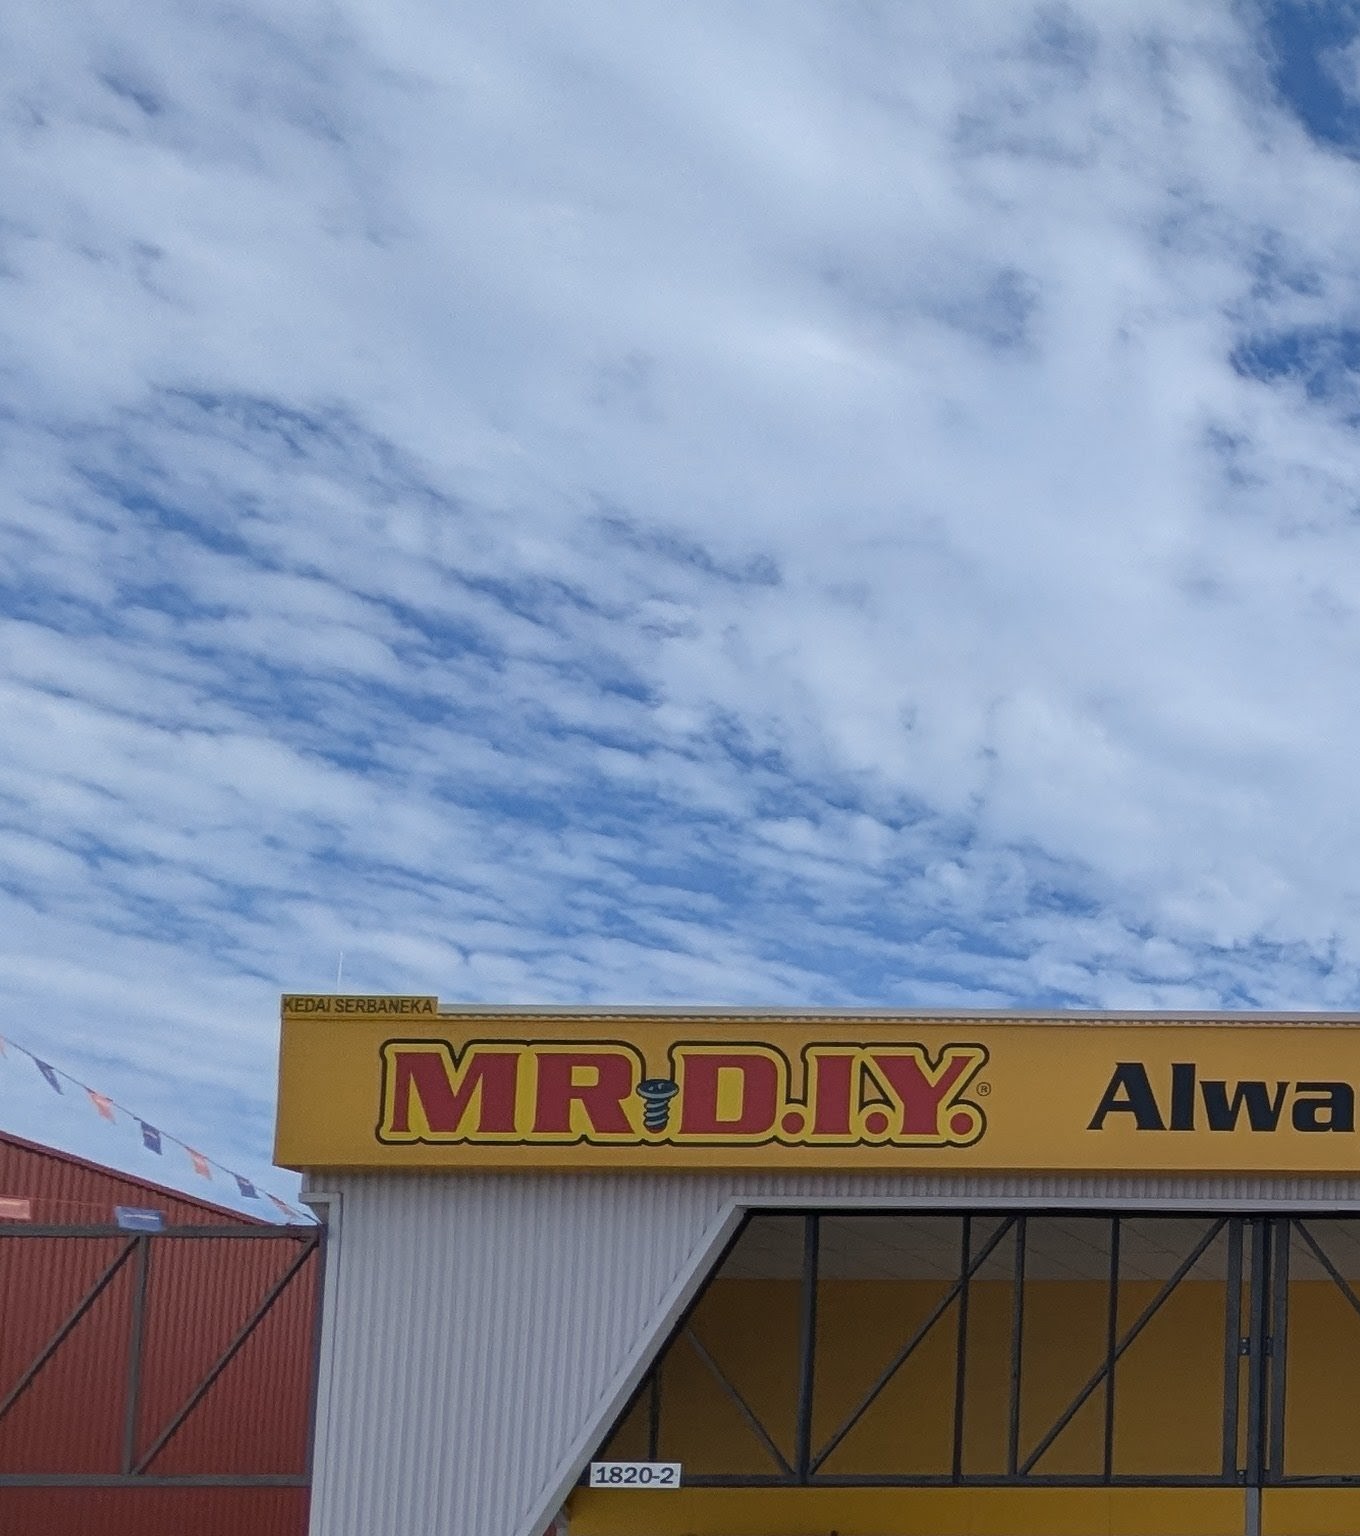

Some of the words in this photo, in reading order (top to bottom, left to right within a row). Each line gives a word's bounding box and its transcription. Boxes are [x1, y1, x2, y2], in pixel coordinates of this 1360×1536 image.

[284, 998, 331, 1013] KEDAI
[335, 998, 433, 1014] SERBANEKA
[595, 1466, 674, 1485] 1820-2
